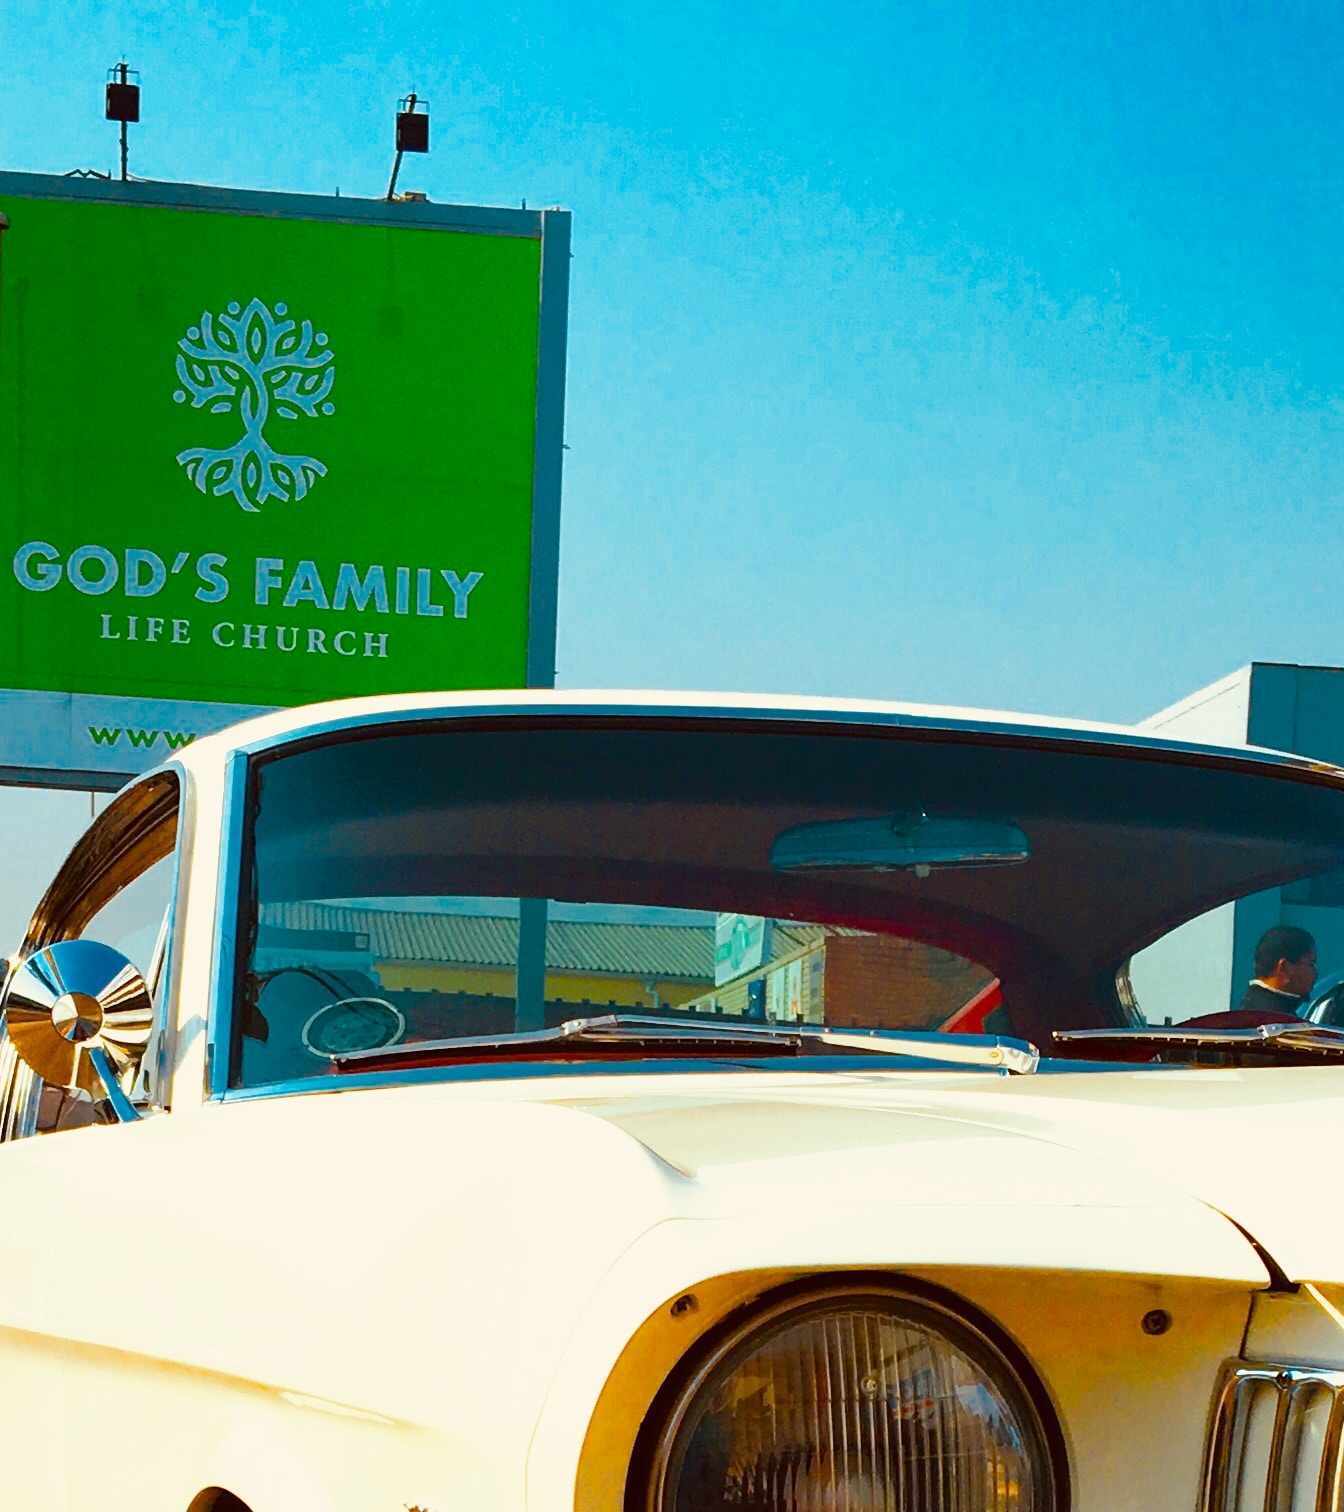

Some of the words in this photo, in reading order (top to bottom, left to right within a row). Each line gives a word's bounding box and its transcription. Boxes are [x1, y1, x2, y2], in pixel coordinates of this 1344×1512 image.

[13, 541, 229, 604] GOD'S
[256, 557, 484, 619] FAMILY
[100, 614, 192, 644] LIFE
[212, 621, 390, 658] CHURCH
